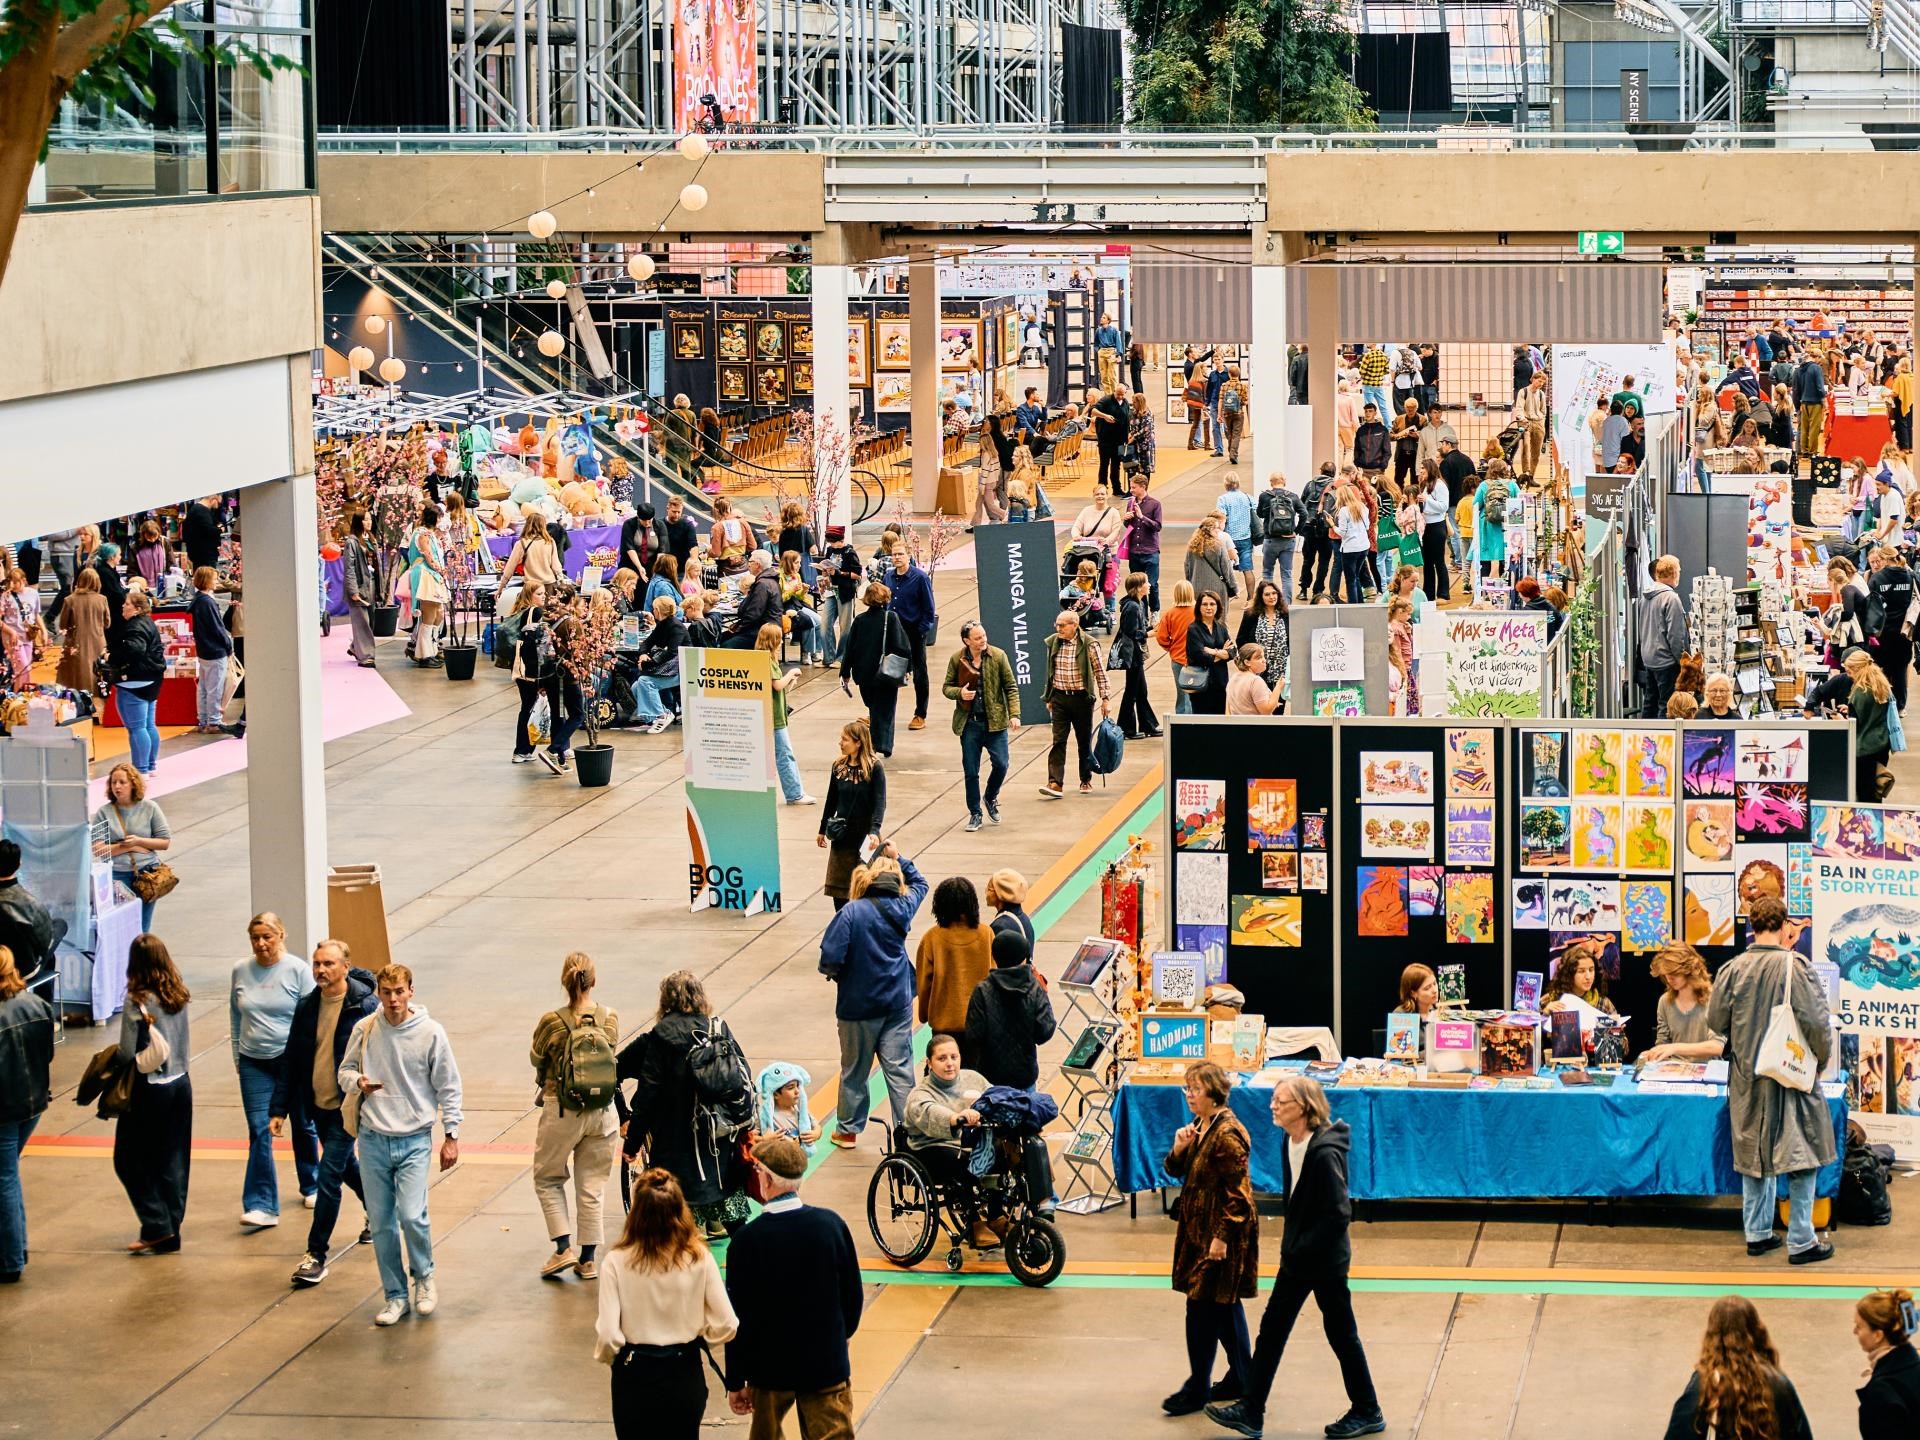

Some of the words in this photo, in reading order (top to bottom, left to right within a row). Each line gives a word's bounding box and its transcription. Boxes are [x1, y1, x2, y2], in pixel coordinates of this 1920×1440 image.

[1629, 72, 1640, 87] NY
[1629, 89, 1640, 123] SCENE
[1723, 267, 1756, 275] Kristeligt
[1758, 267, 1788, 275] Dagblad
[1007, 543, 1026, 610] MANGA
[1452, 618, 1482, 643] Max
[1484, 626, 1497, 637] og
[1499, 618, 1536, 643] Meta
[1013, 612, 1031, 685] VILLAGE
[1320, 634, 1345, 649] Gratis
[700, 668, 749, 679] COSPLAY
[1460, 660, 1476, 673] Kun
[1480, 660, 1488, 671] et
[1491, 660, 1538, 677] fingerknips
[697, 679, 715, 688] VIS
[718, 680, 763, 691] HENSYN
[1468, 673, 1484, 687] fra
[689, 863, 744, 888] BOG
[1820, 865, 1843, 878] BA
[1850, 867, 1866, 879] IN
[1820, 880, 1919, 896] STORYTELL
[1858, 1001, 1919, 1015] ANIMAT
[1842, 1013, 1917, 1029] ORKSH
[1150, 1023, 1198, 1054] HANDMADE
[1182, 1044, 1203, 1056] DICE
